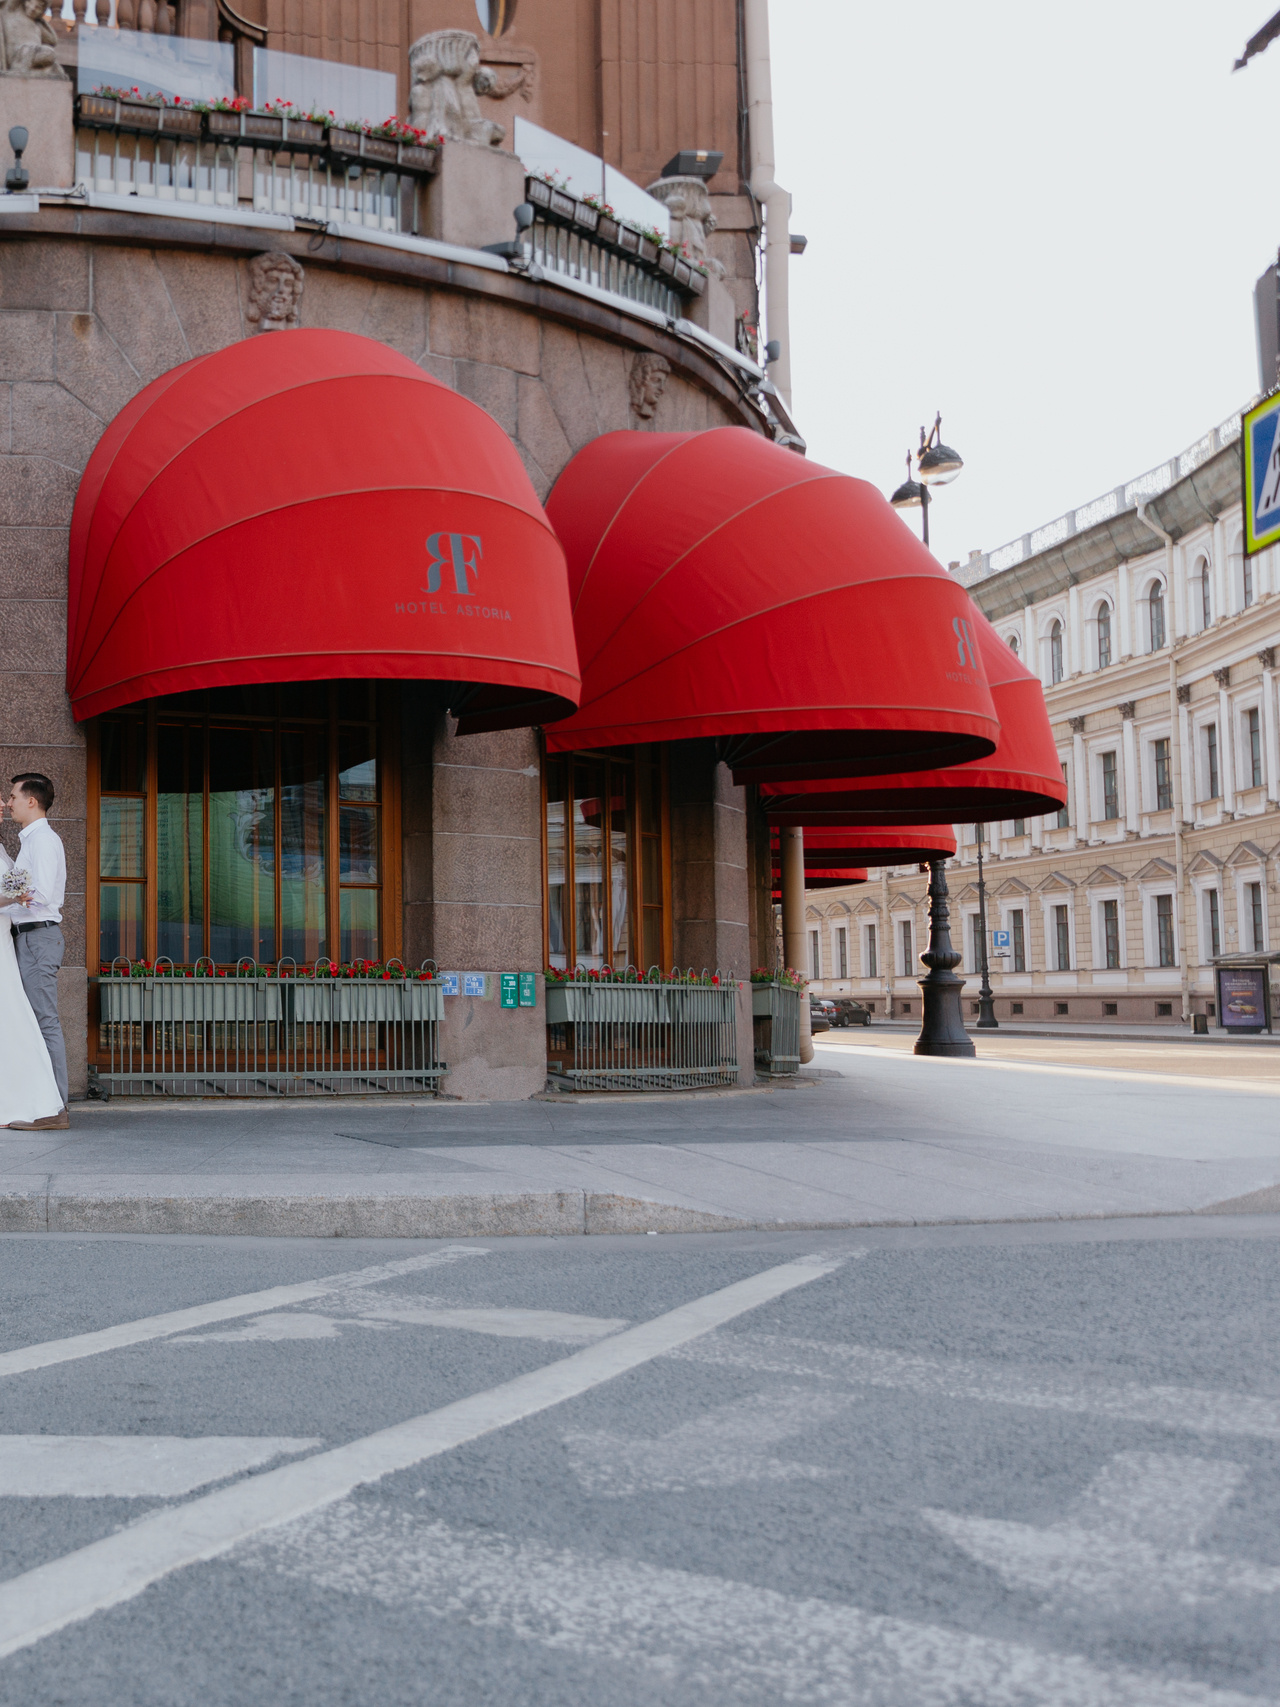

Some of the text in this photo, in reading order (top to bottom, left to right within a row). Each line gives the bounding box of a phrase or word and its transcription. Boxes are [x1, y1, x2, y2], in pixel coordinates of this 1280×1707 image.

[395, 602, 512, 621] HOTEL ASTORIA
[945, 671, 972, 685] HOTEL
[997, 932, 1008, 946] P
